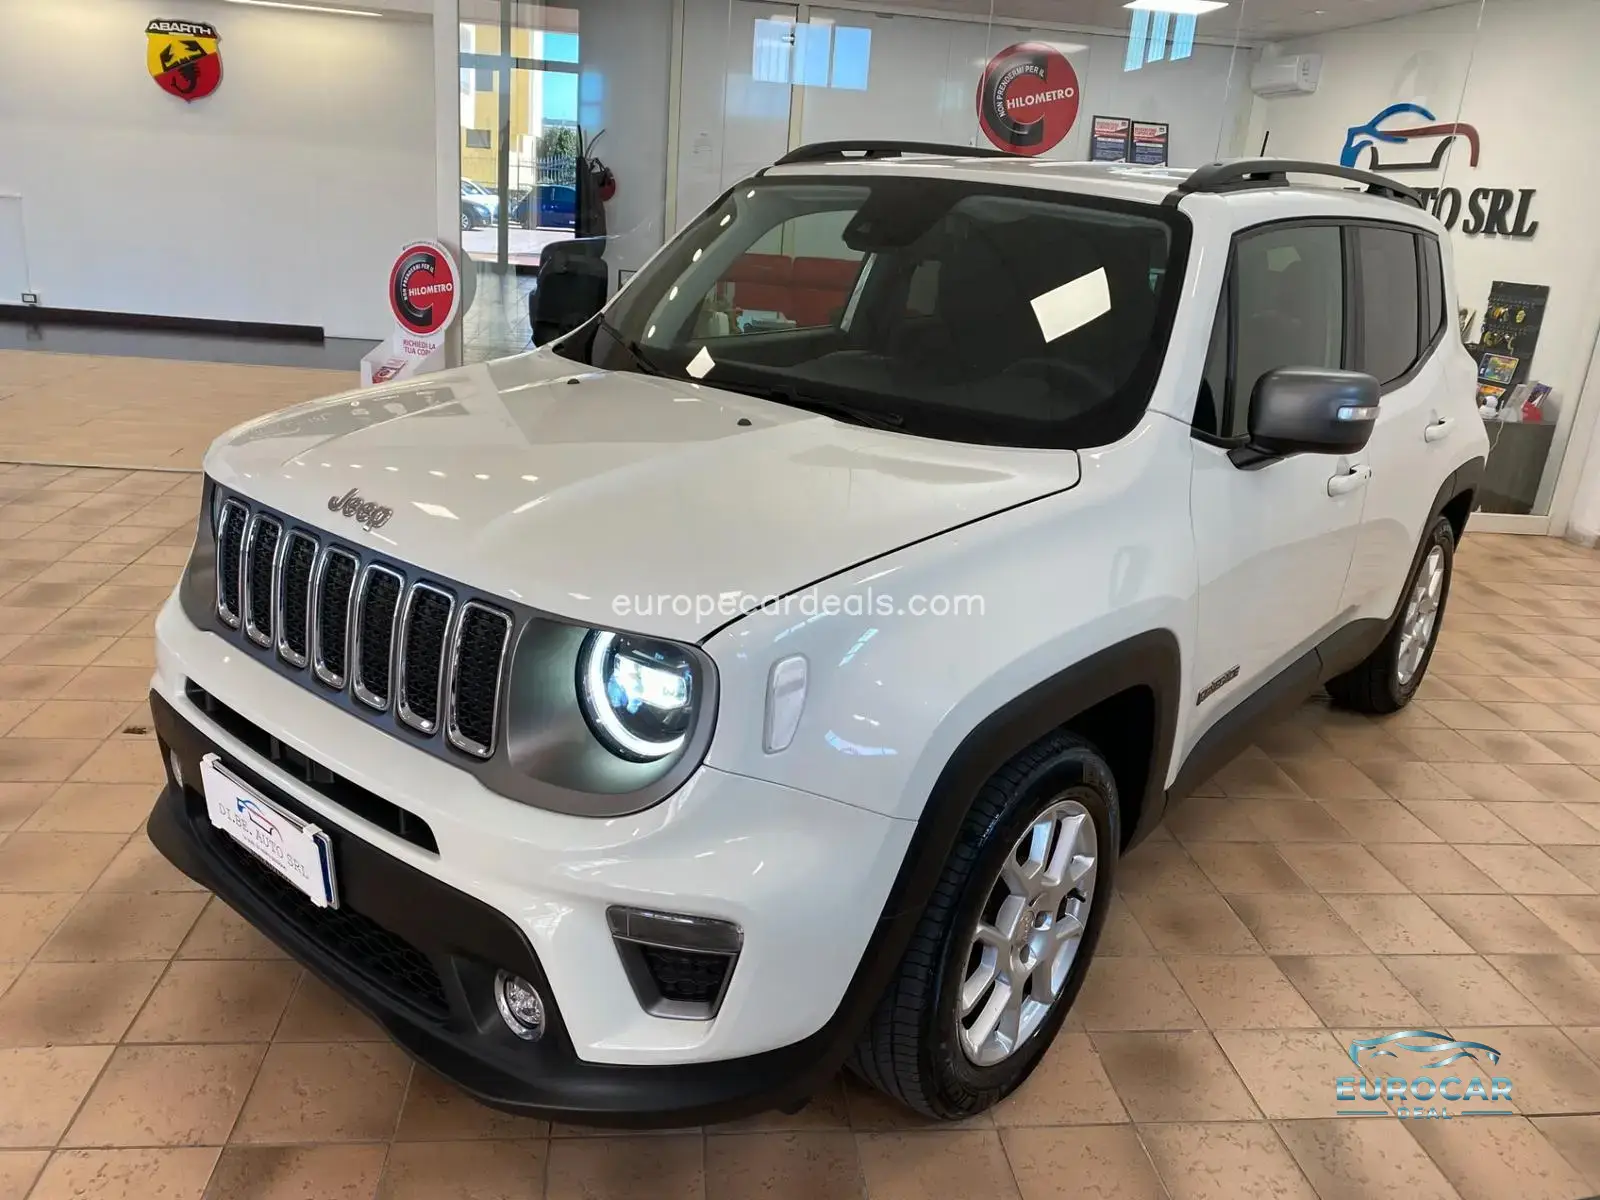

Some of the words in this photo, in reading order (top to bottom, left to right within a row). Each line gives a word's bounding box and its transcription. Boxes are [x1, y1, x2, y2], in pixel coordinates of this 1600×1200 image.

[149, 22, 211, 35] ABARTH
[1025, 65, 1038, 74] PER
[996, 66, 1025, 100] PRENDERMI
[996, 101, 1006, 118] NON
[1462, 187, 1539, 236] SRL
[403, 340, 429, 350] RICHIEDI
[404, 347, 416, 355] TUA
[328, 488, 393, 532] Jeep
[256, 829, 284, 860] AUTO
[286, 853, 310, 880] SRL
